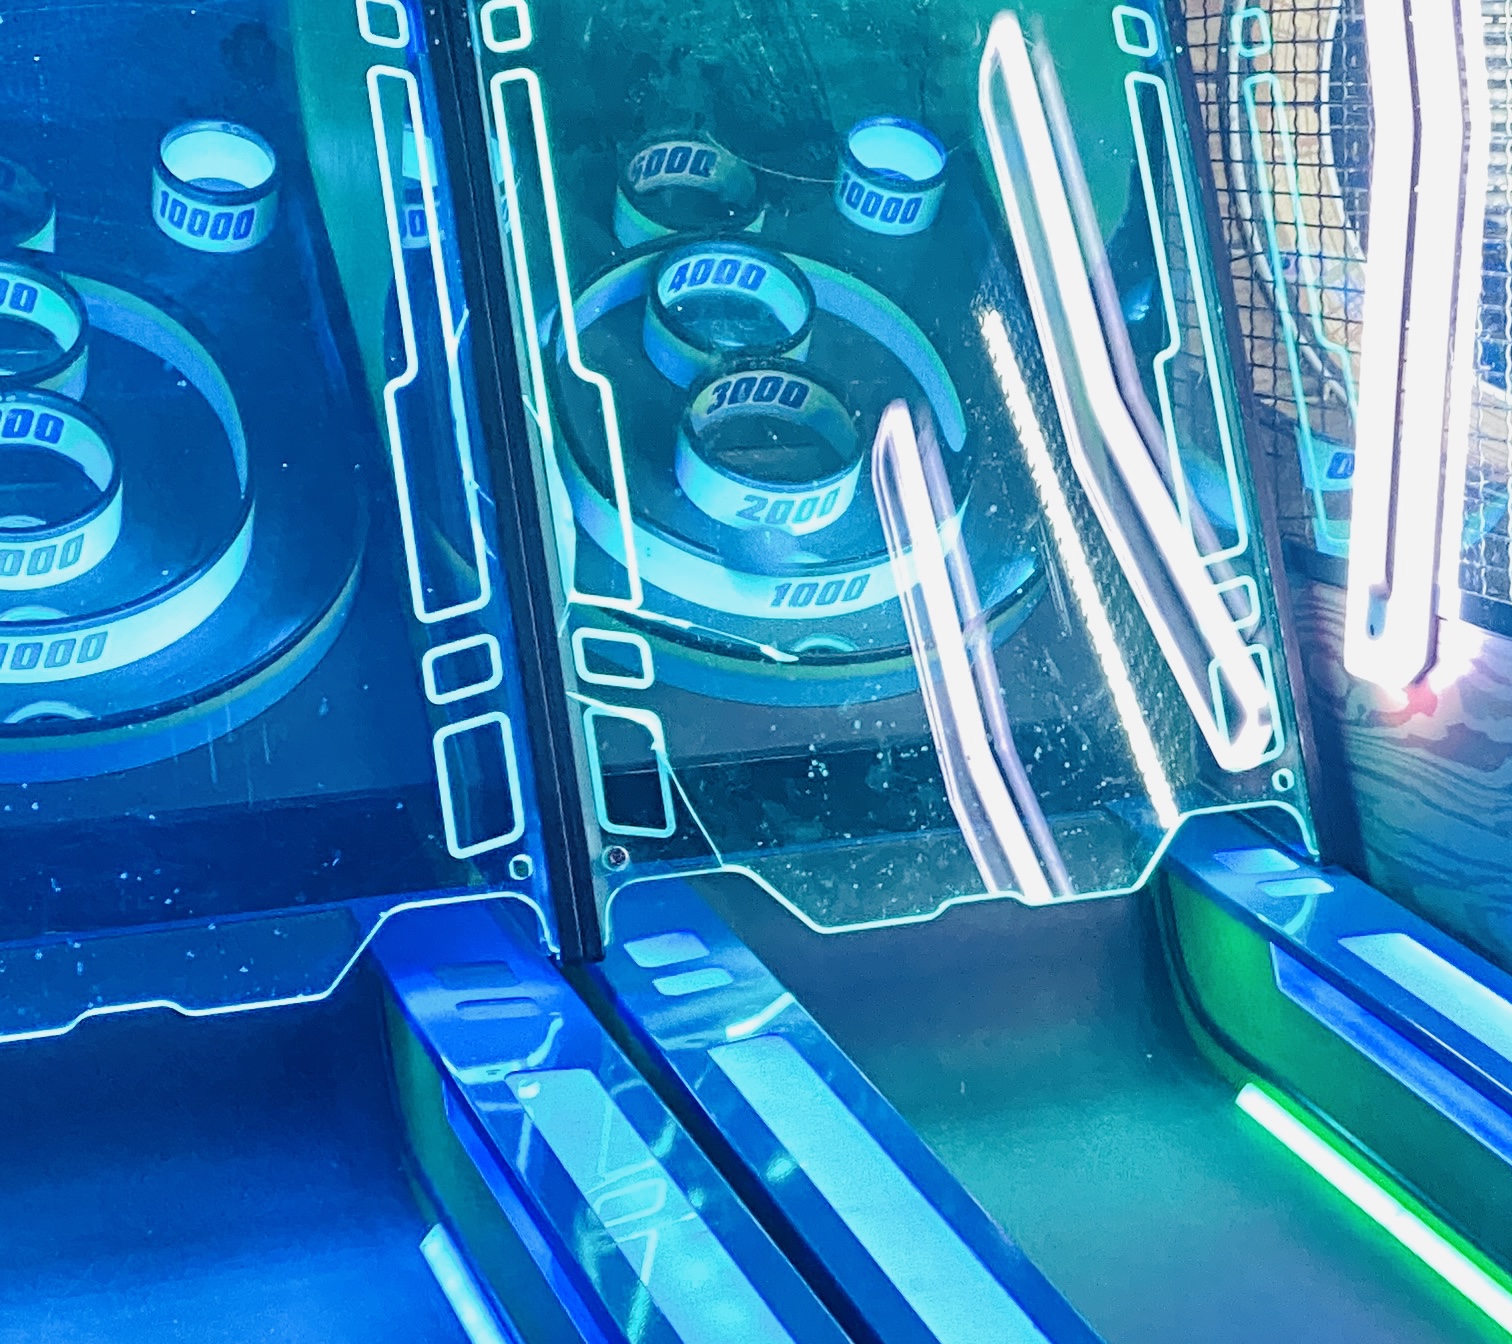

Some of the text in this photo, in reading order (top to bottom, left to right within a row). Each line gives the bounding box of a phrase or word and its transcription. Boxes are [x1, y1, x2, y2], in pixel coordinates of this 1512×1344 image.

[159, 189, 255, 241] 10000
[840, 172, 922, 225] 10000
[667, 258, 767, 292] 4000
[706, 375, 810, 410] 3000
[736, 487, 841, 525] 2000
[770, 572, 869, 608] 1000
[0, 630, 108, 671] 000
